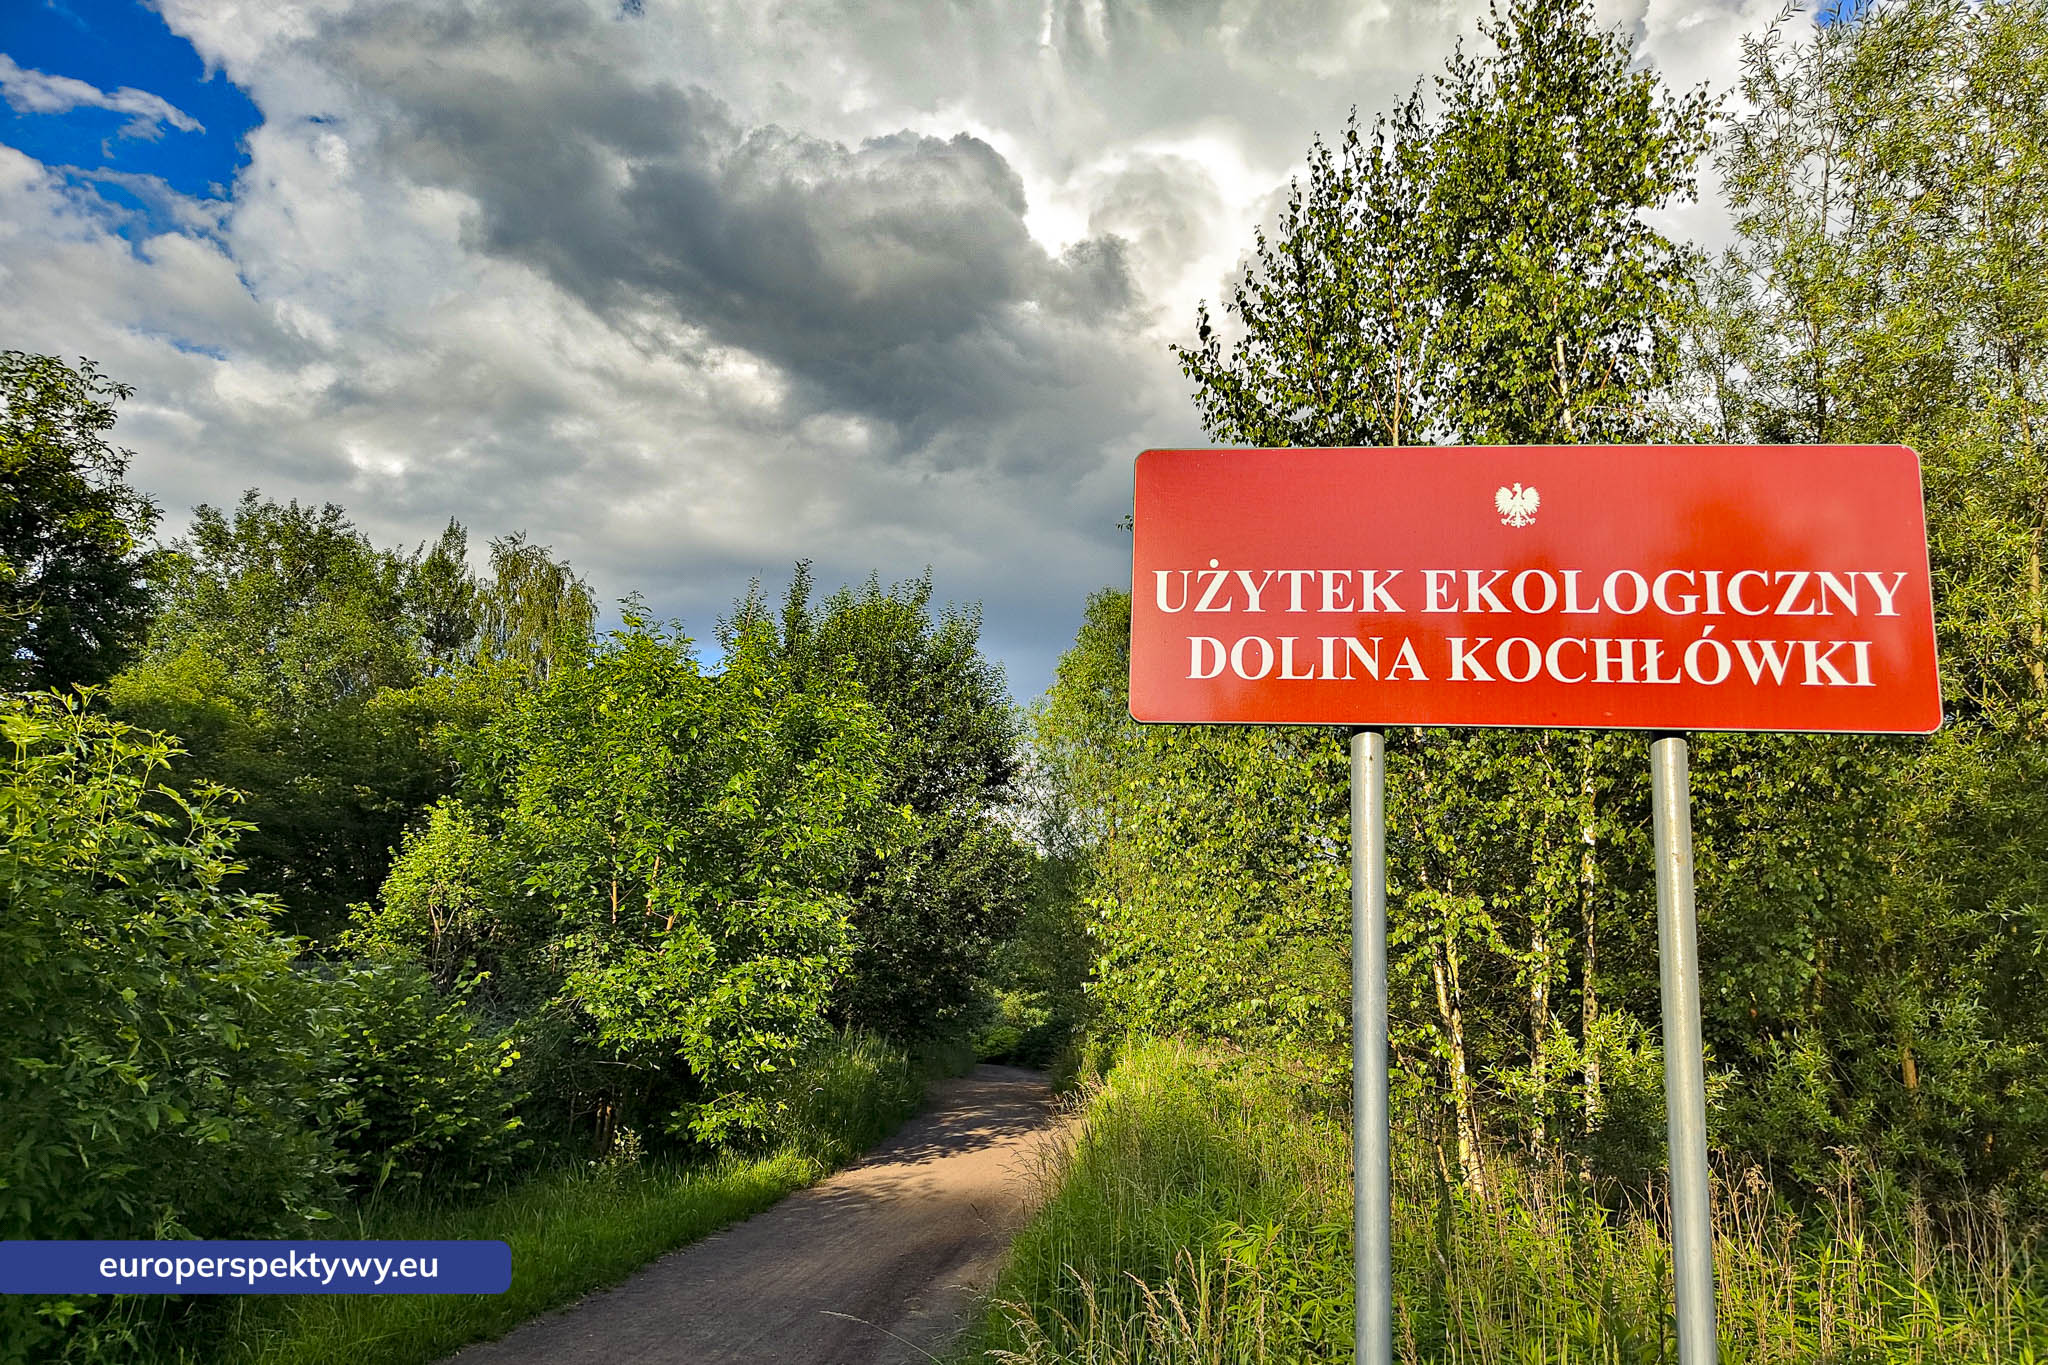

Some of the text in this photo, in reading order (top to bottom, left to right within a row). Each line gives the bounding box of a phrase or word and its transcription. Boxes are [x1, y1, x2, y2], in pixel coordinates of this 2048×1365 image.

[1152, 558, 1908, 617] UŻYTEK EKOLOGICZNY
[1185, 625, 1877, 687] DOLINA KOCHŁÓWKI
